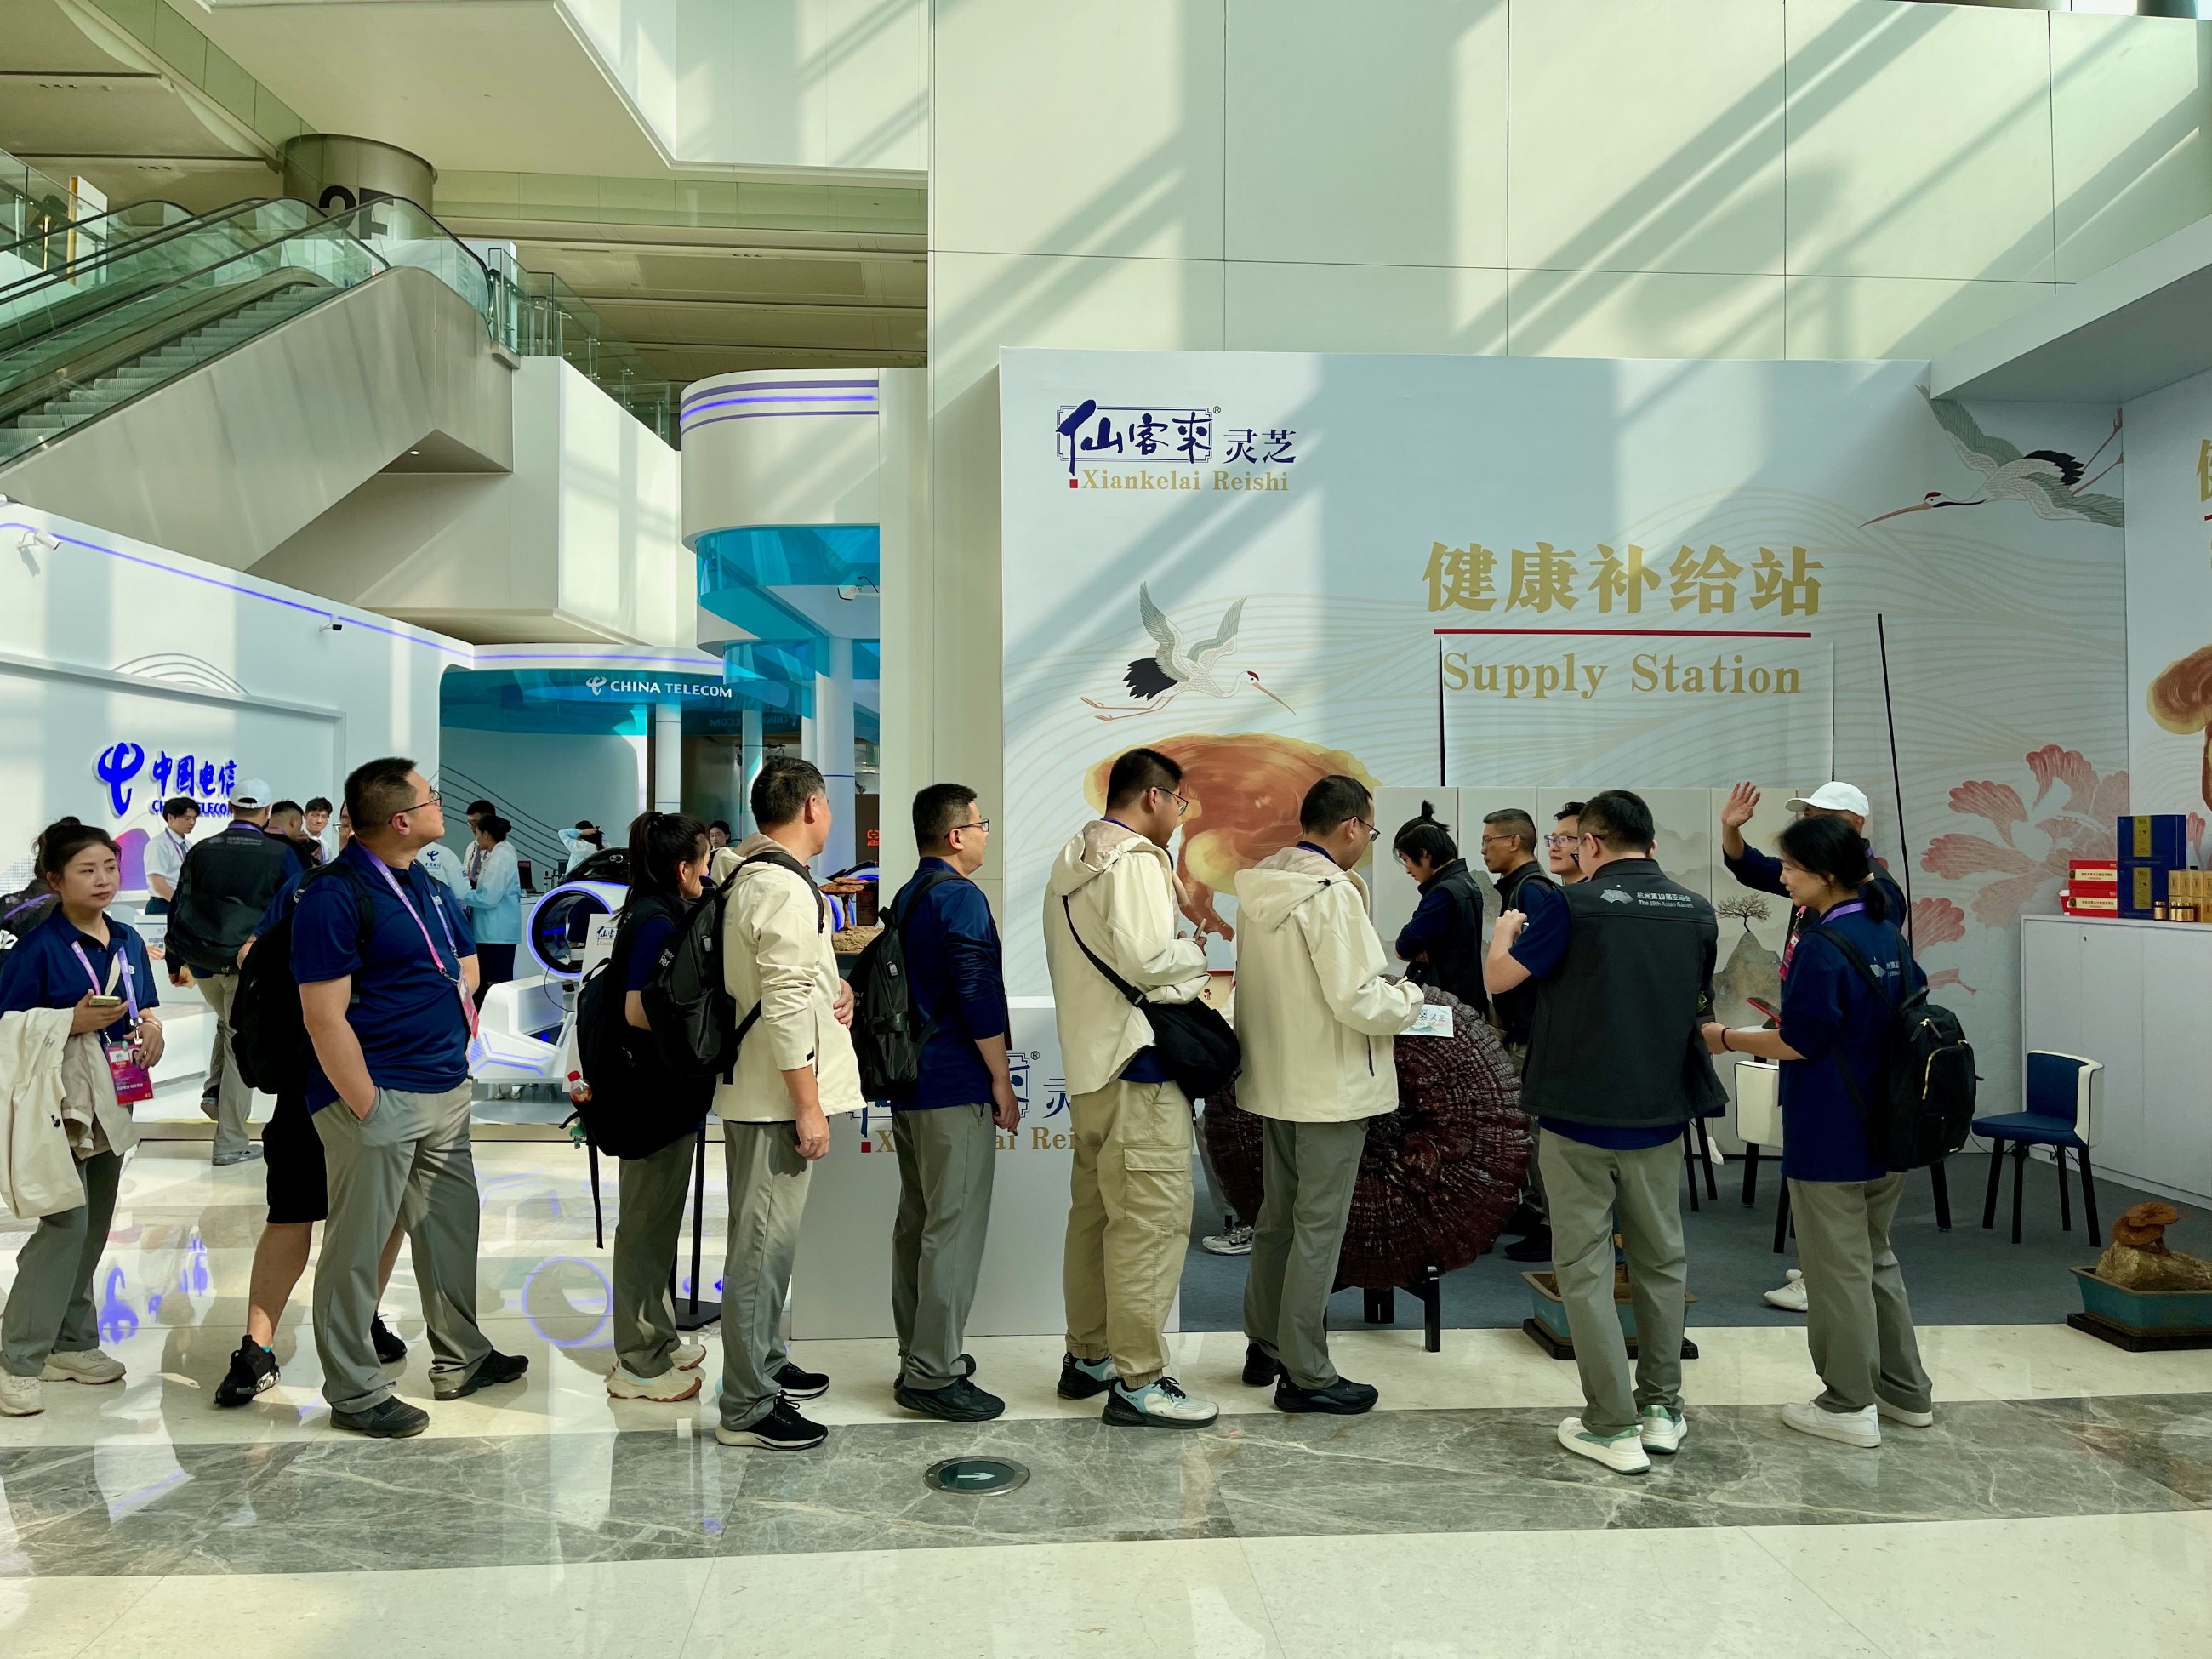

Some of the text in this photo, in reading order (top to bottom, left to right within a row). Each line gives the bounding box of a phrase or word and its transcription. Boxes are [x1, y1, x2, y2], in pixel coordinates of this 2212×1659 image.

[1223, 428, 1297, 464] 灵芝
[1080, 469, 1289, 491] Xiankelai Reishi
[1422, 541, 1824, 616] 健康补给站
[610, 681, 733, 698] CHINA TELECOM
[1443, 652, 1802, 700] Supply Station
[152, 750, 237, 798] 中国电信
[1030, 1126, 1077, 1150] Rei
